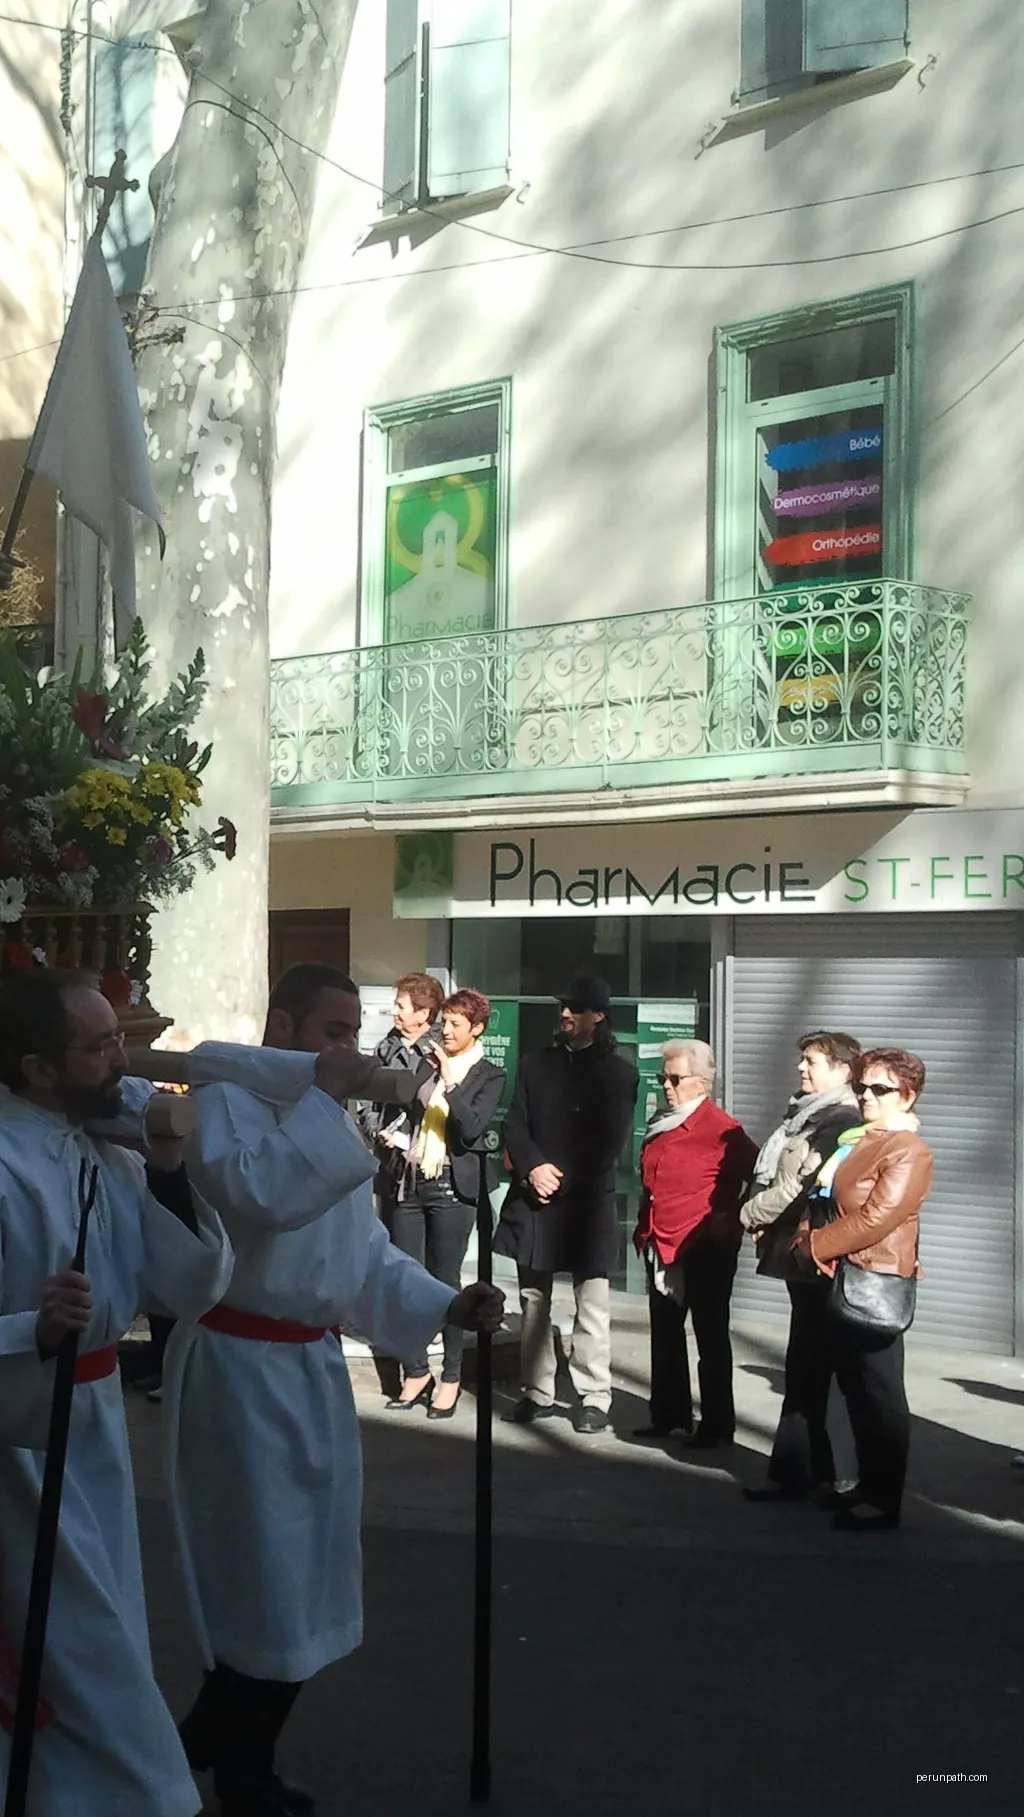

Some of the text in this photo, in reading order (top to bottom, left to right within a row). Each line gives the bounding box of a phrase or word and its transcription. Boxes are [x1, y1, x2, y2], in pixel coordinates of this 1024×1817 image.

[849, 436, 881, 451] Bébé
[773, 483, 880, 510] Dermocosmétique
[812, 531, 880, 552] Orthopédie
